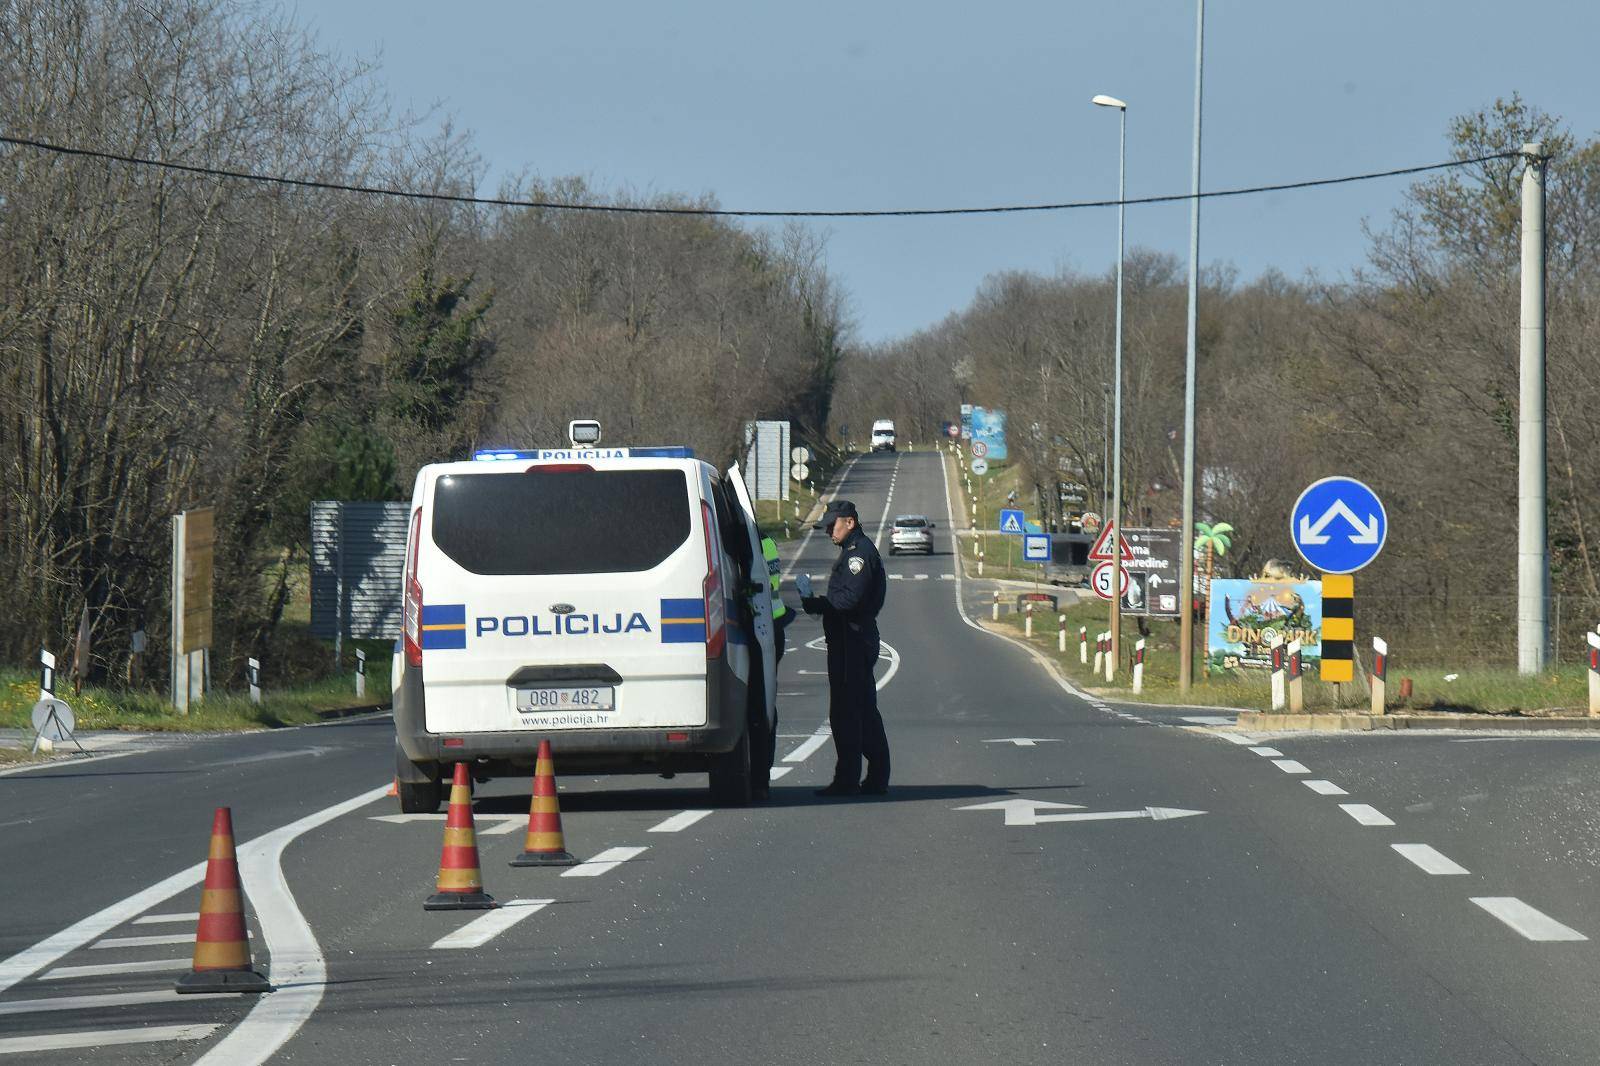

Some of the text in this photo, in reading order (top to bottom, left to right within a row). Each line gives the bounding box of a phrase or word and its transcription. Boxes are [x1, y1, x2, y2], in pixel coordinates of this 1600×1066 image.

[543, 450, 624, 460] POLICIJA
[476, 612, 652, 638] POLICIJA
[530, 689, 599, 706] 080 482
[522, 714, 608, 727] www.policija.hr
